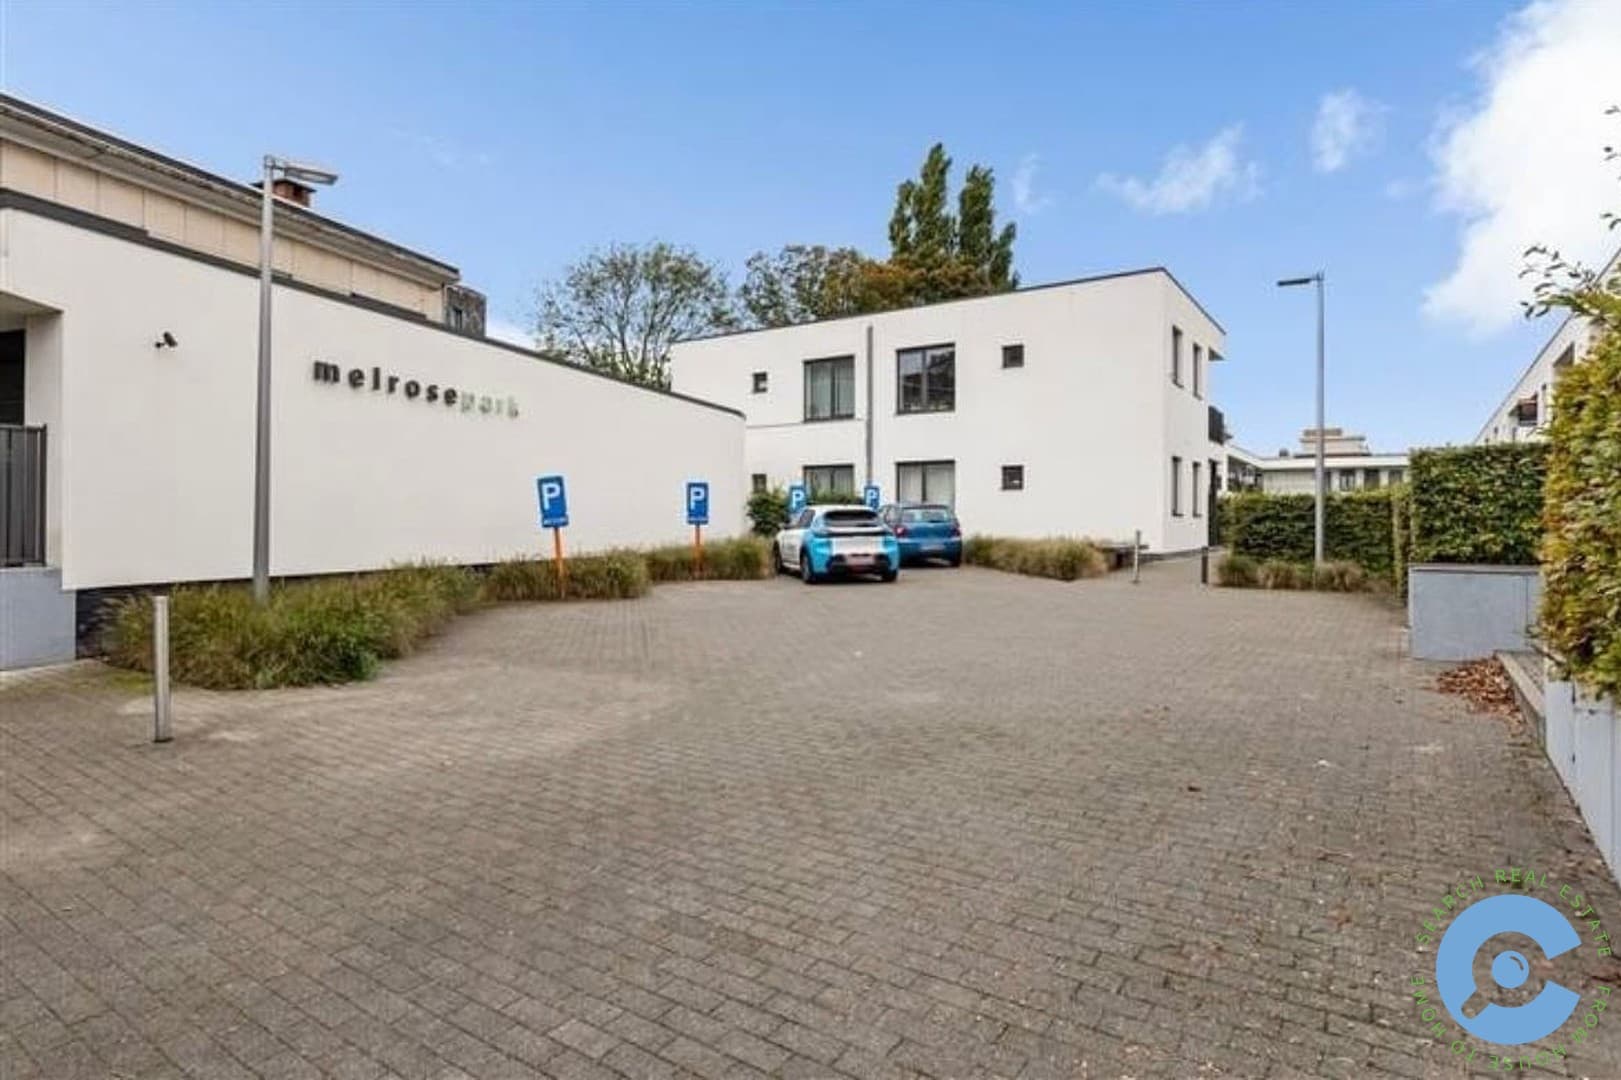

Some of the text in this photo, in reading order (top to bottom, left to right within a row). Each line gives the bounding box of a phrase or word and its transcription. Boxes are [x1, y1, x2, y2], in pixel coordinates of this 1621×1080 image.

[541, 482, 561, 511] P
[690, 486, 705, 511] P
[792, 489, 805, 510] P
[866, 489, 878, 507] P
